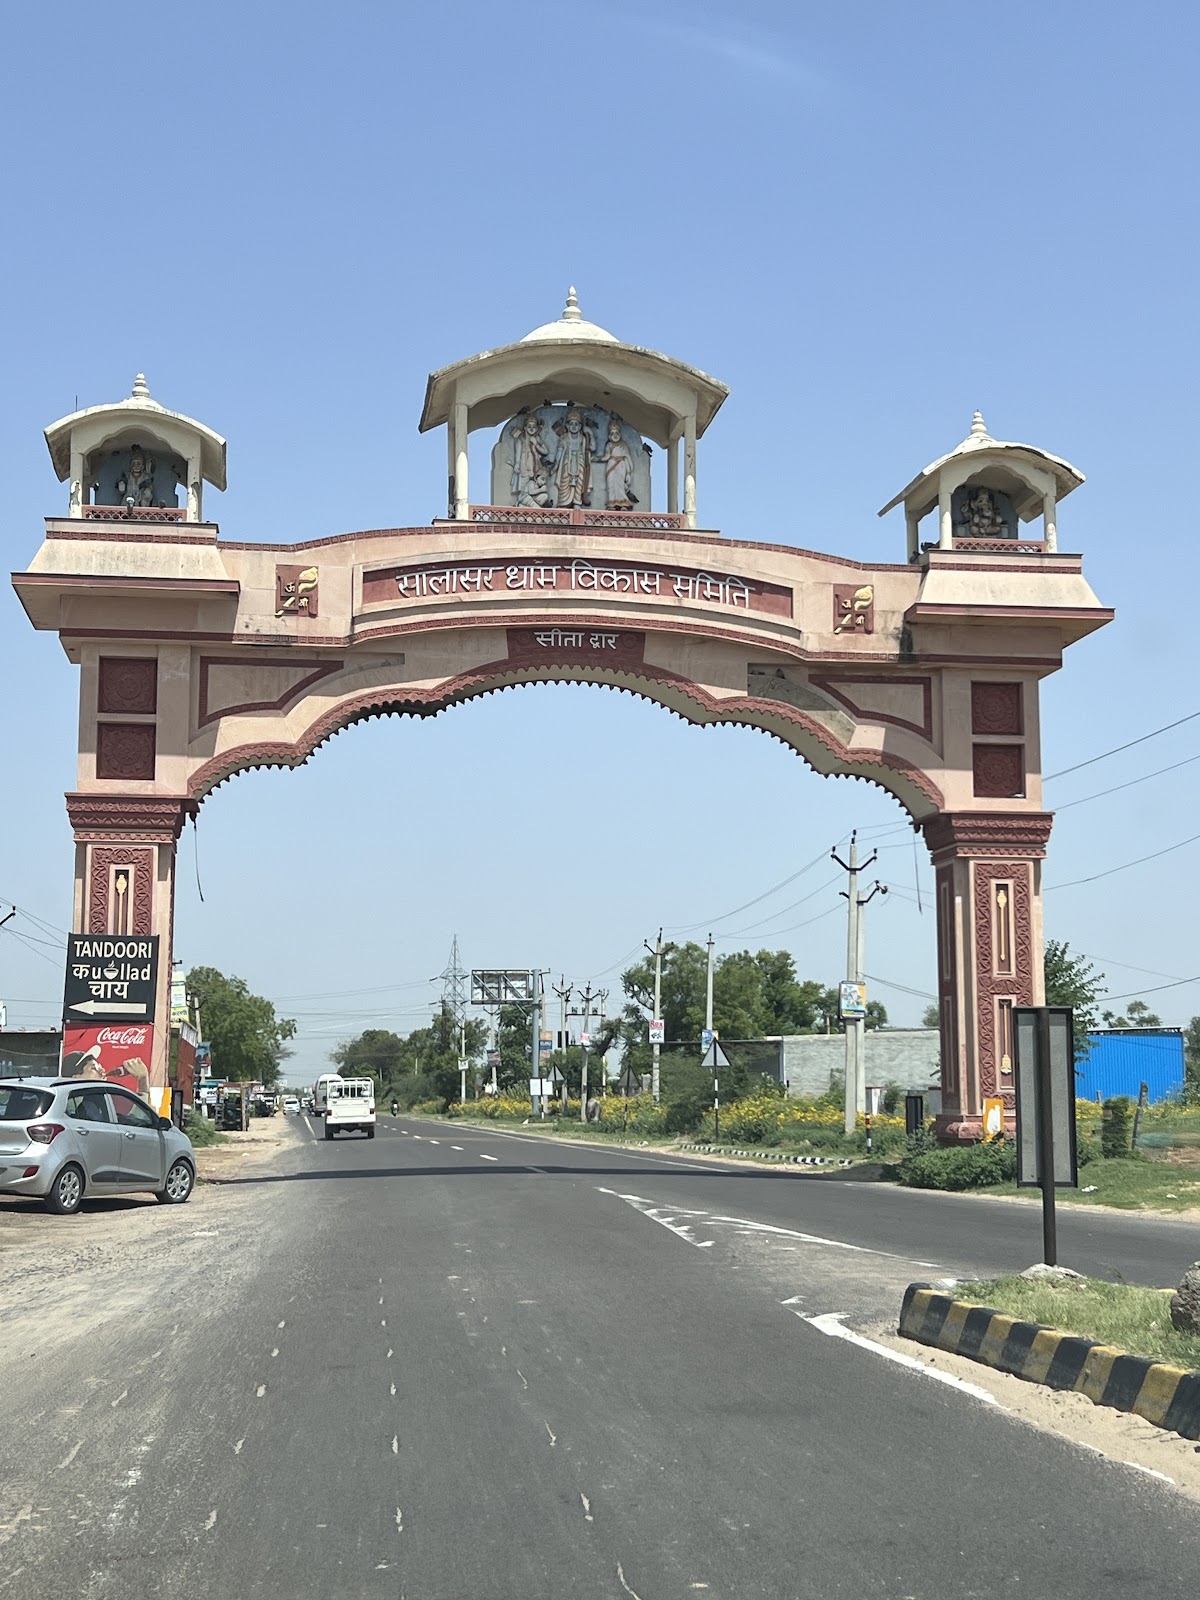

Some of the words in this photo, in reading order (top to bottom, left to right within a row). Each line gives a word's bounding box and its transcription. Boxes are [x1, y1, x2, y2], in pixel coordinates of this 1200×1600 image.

[395, 566, 503, 598] सालासर
[506, 565, 561, 589] धाम
[564, 559, 664, 594] विकास
[669, 572, 755, 609] समिति
[534, 628, 585, 648] सीता
[588, 632, 619, 650] द्वार
[74, 941, 152, 958] TANDOORI
[88, 981, 129, 999] चाय
[97, 1027, 148, 1044] Coca-Cola
